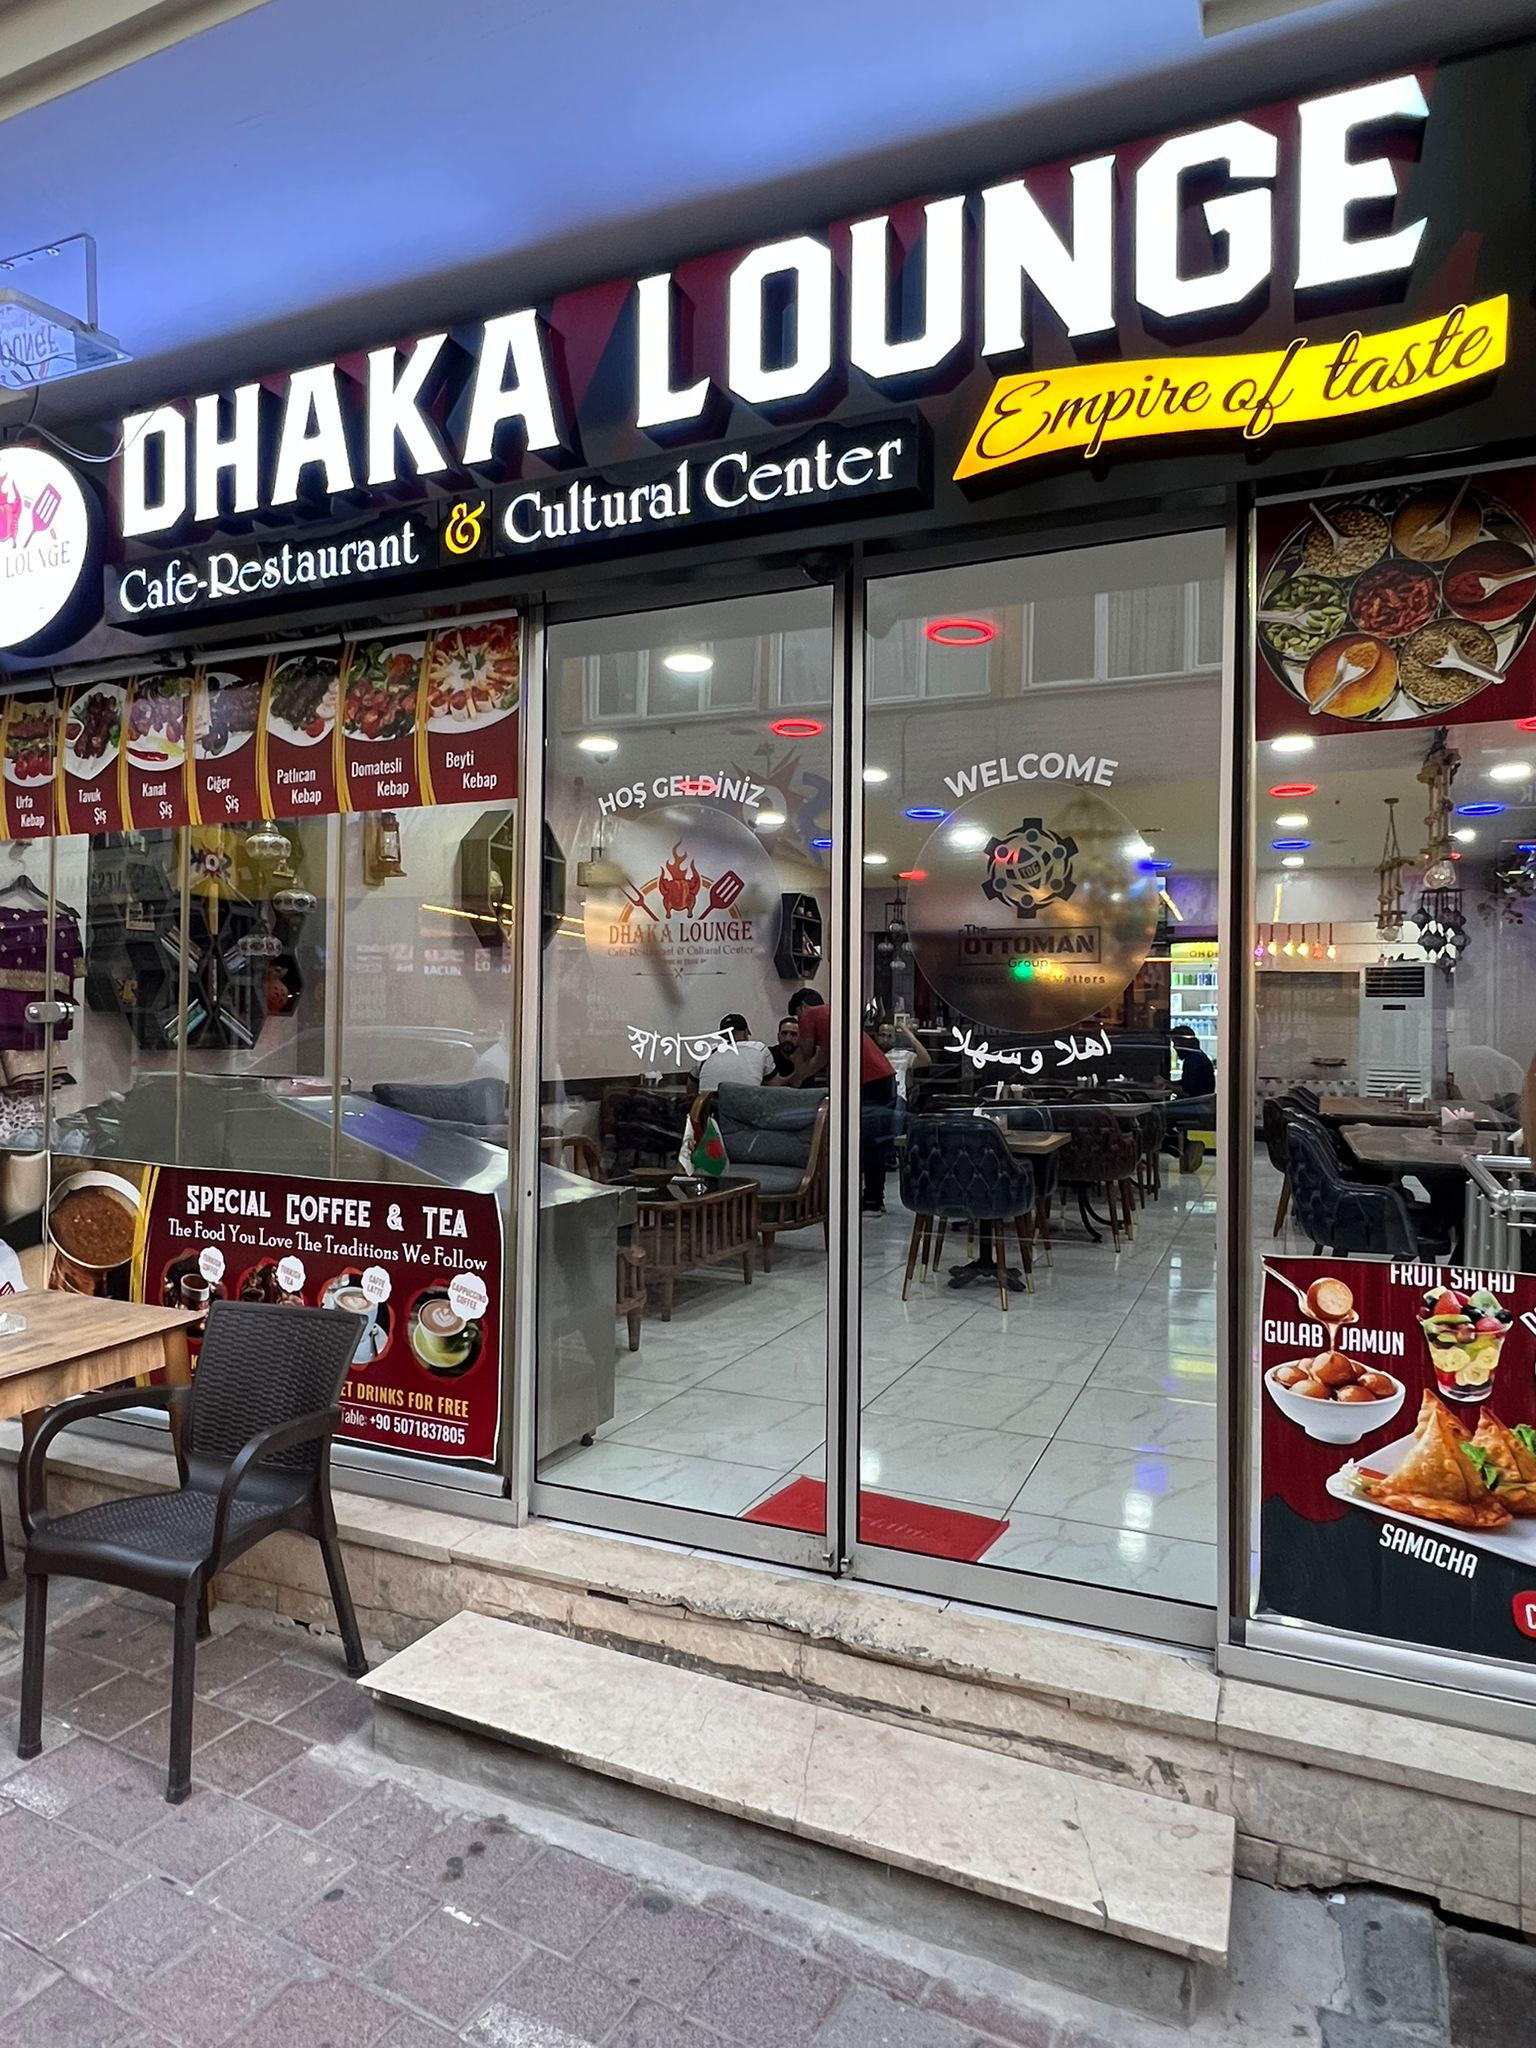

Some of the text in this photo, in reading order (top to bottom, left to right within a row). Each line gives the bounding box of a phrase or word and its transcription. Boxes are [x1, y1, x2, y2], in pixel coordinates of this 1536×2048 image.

[122, 74, 1430, 538] DHAKA LOUNGE
[975, 305, 1494, 458] Empire of taste
[119, 437, 902, 614] Cafe-Restaurant & Cultural Center
[351, 757, 402, 778] Domatesli
[446, 750, 475, 769] Beyti
[207, 775, 232, 793] Ciğer
[462, 772, 497, 790] Kebap
[944, 752, 1120, 798] WELCOME
[79, 789, 102, 803] Tavuk
[142, 781, 167, 798] Kanat
[291, 787, 322, 805] Kebap
[377, 781, 409, 797] Kebap
[598, 770, 766, 816] HOŞ GELDİNİZ
[16, 795, 34, 810] Urfa
[159, 801, 173, 820] Şiş
[225, 795, 240, 813] Şiş
[21, 814, 45, 830] Kebap
[94, 807, 107, 825] Şiş
[609, 921, 752, 945] DHAKA LOUNGE
[963, 924, 988, 936] The
[964, 935, 1095, 955] OTTOMAN
[1007, 957, 1049, 970] Group
[627, 1024, 739, 1067] স্বাগতম
[187, 1185, 468, 1239] SPECIAL COFFEE & TEA
[168, 1217, 488, 1271] The Food You Love The Traditions We Follow
[1264, 1318, 1405, 1357] GULAB JAMUN
[357, 1383, 404, 1406] DRINKS
[408, 1392, 433, 1412] FOR
[438, 1396, 469, 1418] FREE
[370, 1413, 390, 1431] +90
[393, 1416, 466, 1445] 5071837805
[1379, 1523, 1479, 1580] SAMOCHA
